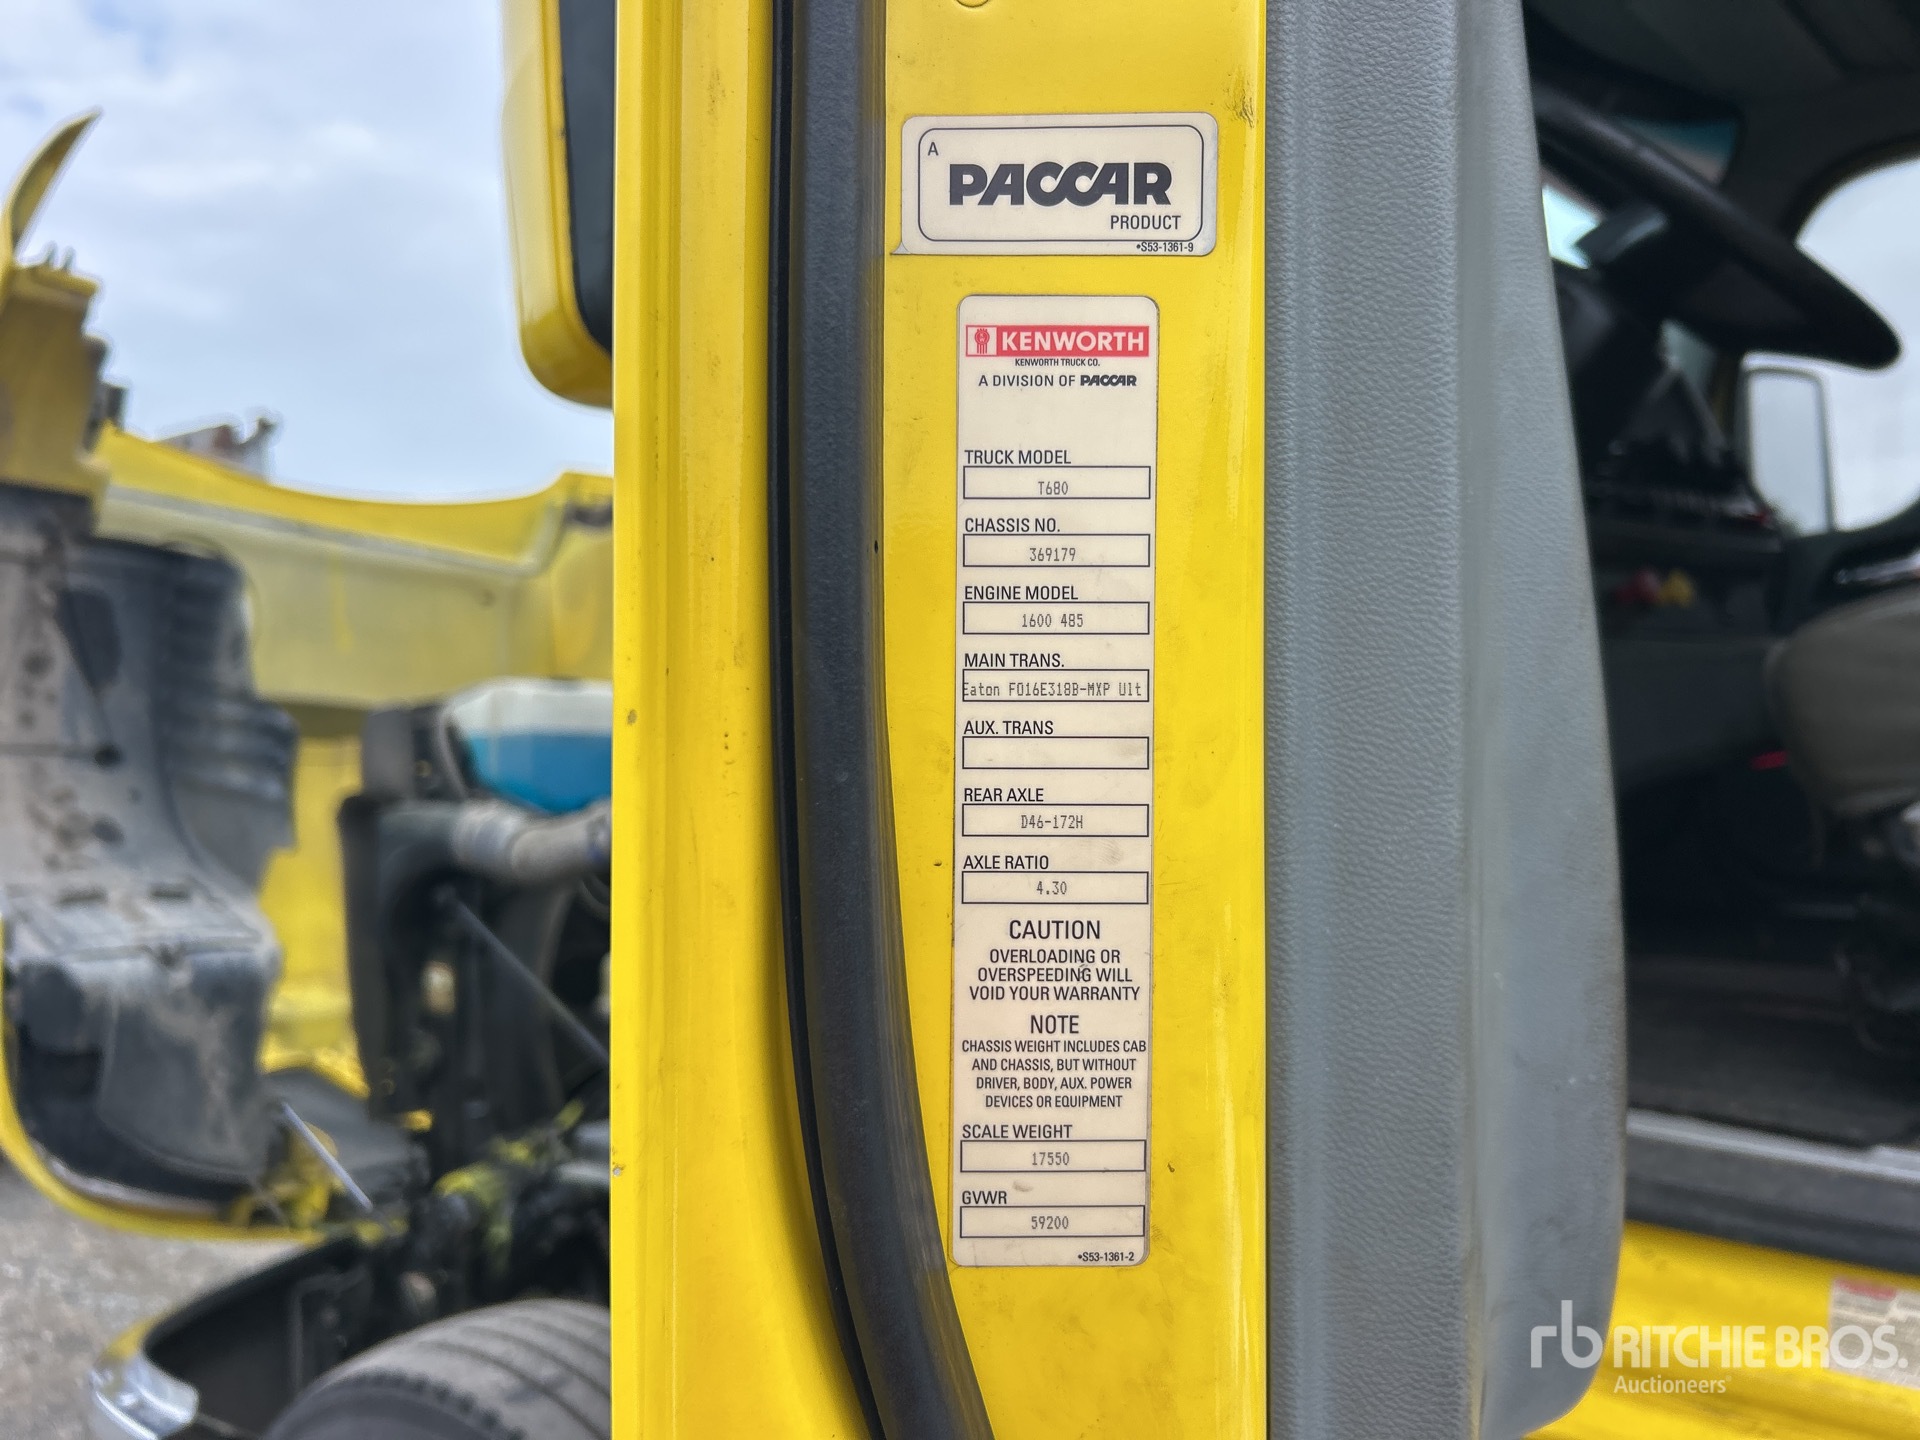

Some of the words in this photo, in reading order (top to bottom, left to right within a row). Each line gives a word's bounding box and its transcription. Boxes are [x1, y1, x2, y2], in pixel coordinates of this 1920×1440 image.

[927, 141, 939, 156] A
[949, 161, 1172, 206] PACCAR
[1110, 215, 1182, 230] PRODUCT
[1002, 331, 1144, 351] KENWORTH
[1015, 358, 1059, 366] KENWORTH
[1087, 359, 1100, 367] CO.
[978, 375, 988, 386] A
[993, 375, 1054, 387] DIVISION
[1059, 375, 1075, 386] OF
[1080, 374, 1137, 386] PACCAR
[964, 450, 1013, 464] TRUCK
[1018, 450, 1071, 464] MODEL
[1038, 481, 1068, 495] T680
[965, 518, 1030, 532] CHASSIS
[1035, 518, 1060, 532] NO.
[1029, 547, 1076, 562] 369179
[965, 586, 1021, 600] ENGINE
[1025, 586, 1078, 600] MODEL
[1022, 614, 1052, 628] 1600
[1061, 614, 1084, 628] 485
[964, 653, 1005, 667] MAIN
[1010, 653, 1064, 667] TRANS.
[963, 683, 1000, 696] Eaton
[963, 720, 998, 735] AUX.
[1003, 720, 1054, 735] TRANS
[964, 788, 1002, 802] REAR
[1007, 788, 1044, 802] AXLE
[1021, 815, 1083, 829] D46-172H
[963, 855, 1000, 869] AXLE
[1005, 855, 1049, 869] RATIO
[1036, 881, 1067, 895] 4.30
[1009, 920, 1101, 940] CAUTION
[990, 949, 1095, 964] OVERLOADING
[1100, 949, 1120, 963] OR
[978, 967, 1091, 982] OVERSPEEDING
[1096, 968, 1132, 982] WILL
[969, 986, 1005, 1001] VOID
[1010, 986, 1049, 1001] YOUR
[1054, 986, 1140, 1001] WARRANTY
[1030, 1015, 1079, 1034] NOTE
[962, 1040, 1012, 1053] CHASSIS
[1015, 1040, 1060, 1053] WEIGHT
[1064, 1040, 1120, 1053] INCLUDES
[1123, 1040, 1146, 1053] CAB
[972, 1058, 997, 1071] AND
[1001, 1058, 1053, 1073] CHASSIS,
[1057, 1058, 1080, 1071] BUT
[1083, 1058, 1136, 1071] WITHOUT
[976, 1077, 1020, 1091] DRIVER,
[1023, 1077, 1057, 1091] BODY,
[1060, 1077, 1087, 1089] AUX.
[1091, 1077, 1132, 1089] POWER
[985, 1095, 1033, 1108] DEVICES
[1036, 1095, 1054, 1108] OR
[1055, 1095, 1122, 1108] EQUIPMENT
[962, 1124, 1009, 1139] SCALE
[1013, 1124, 1072, 1139] WEIGHT
[1032, 1152, 1069, 1166] 17550
[962, 1191, 1007, 1205] GVWR
[1031, 1216, 1069, 1230] 59200
